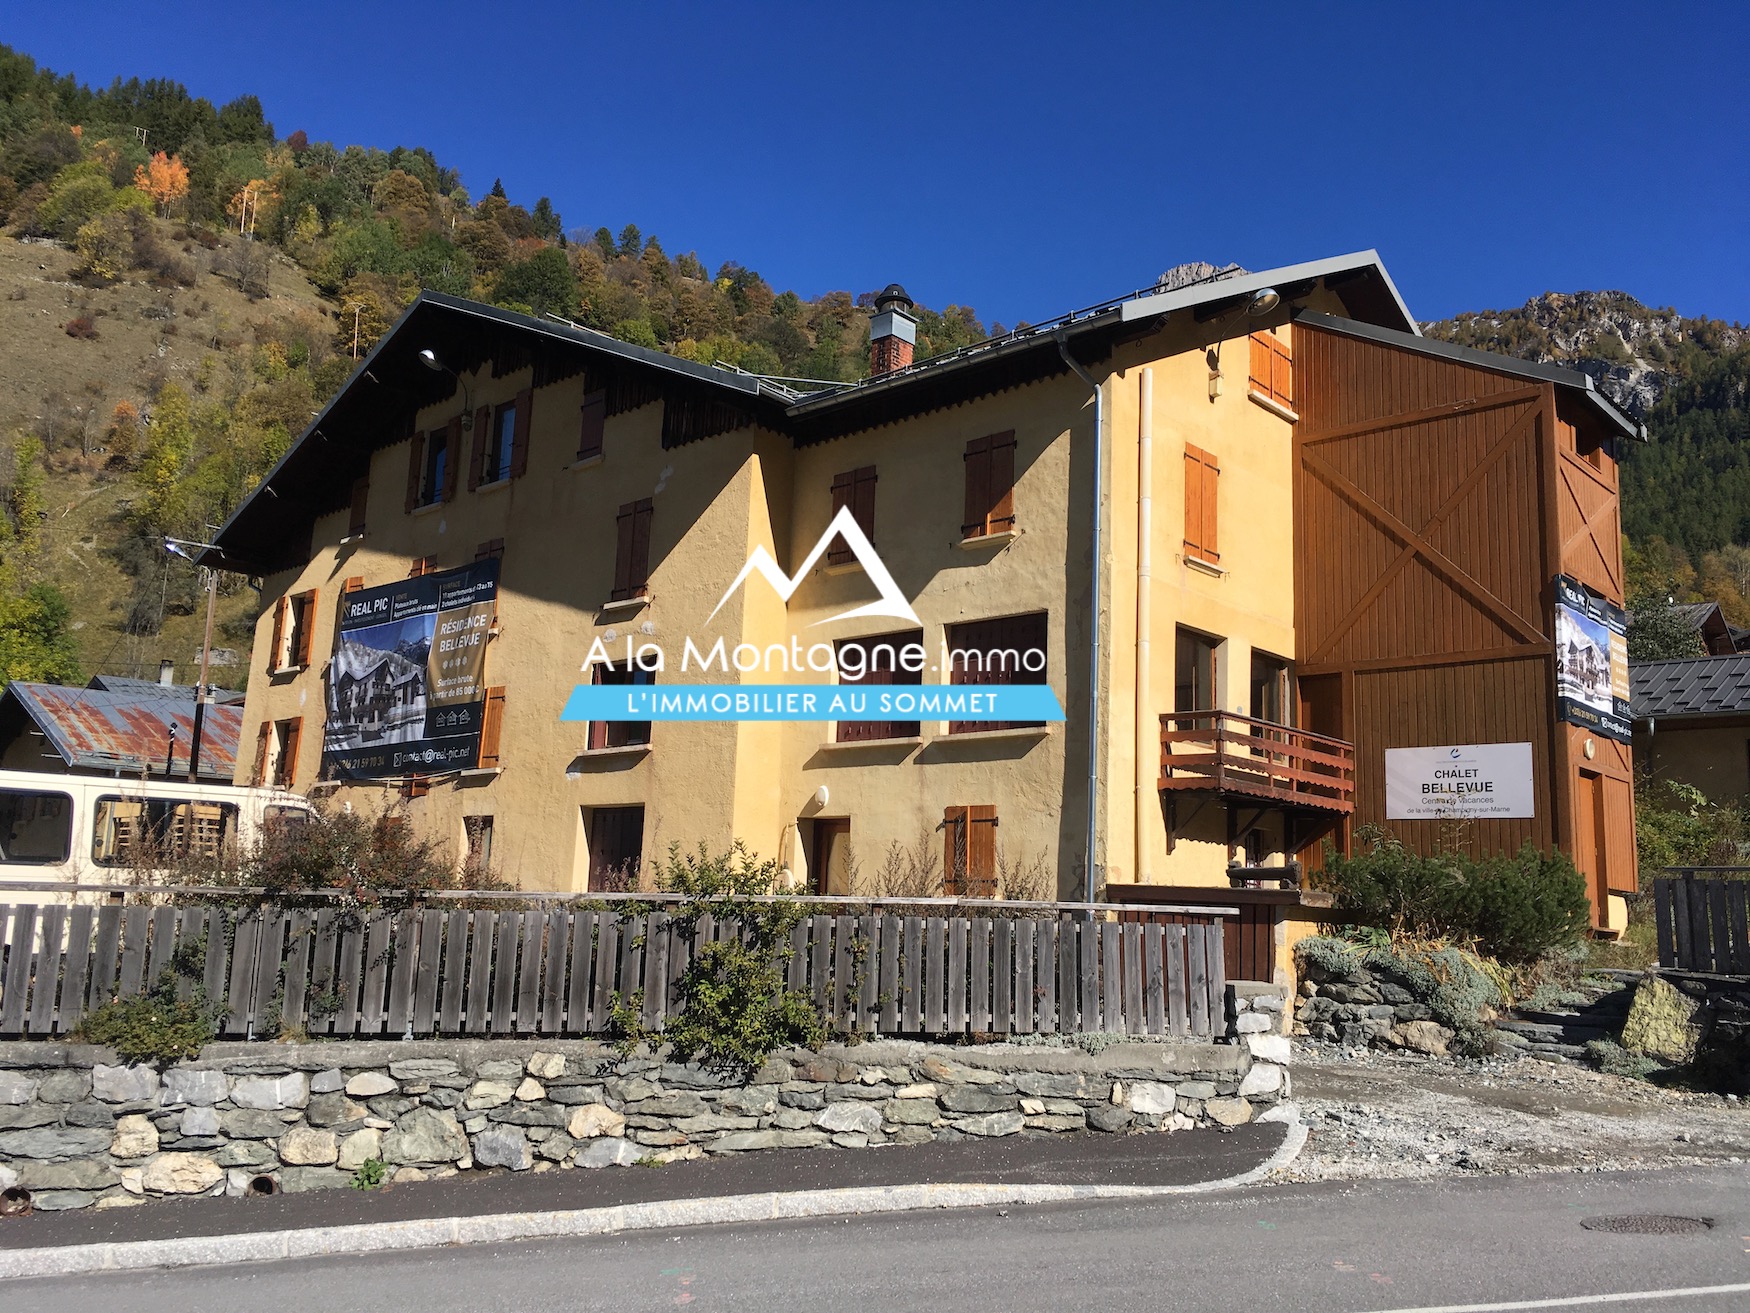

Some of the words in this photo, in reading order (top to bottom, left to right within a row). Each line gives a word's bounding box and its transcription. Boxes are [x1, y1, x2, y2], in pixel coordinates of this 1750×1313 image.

[350, 601, 372, 617] REAL
[373, 597, 388, 612] PIC
[440, 632, 480, 653] BELLEVUE
[437, 678, 457, 687] Surface
[457, 675, 473, 683] brute
[448, 688, 455, 697] de
[1434, 768, 1479, 779] CHALET
[1421, 781, 1494, 794] BELLEVUE
